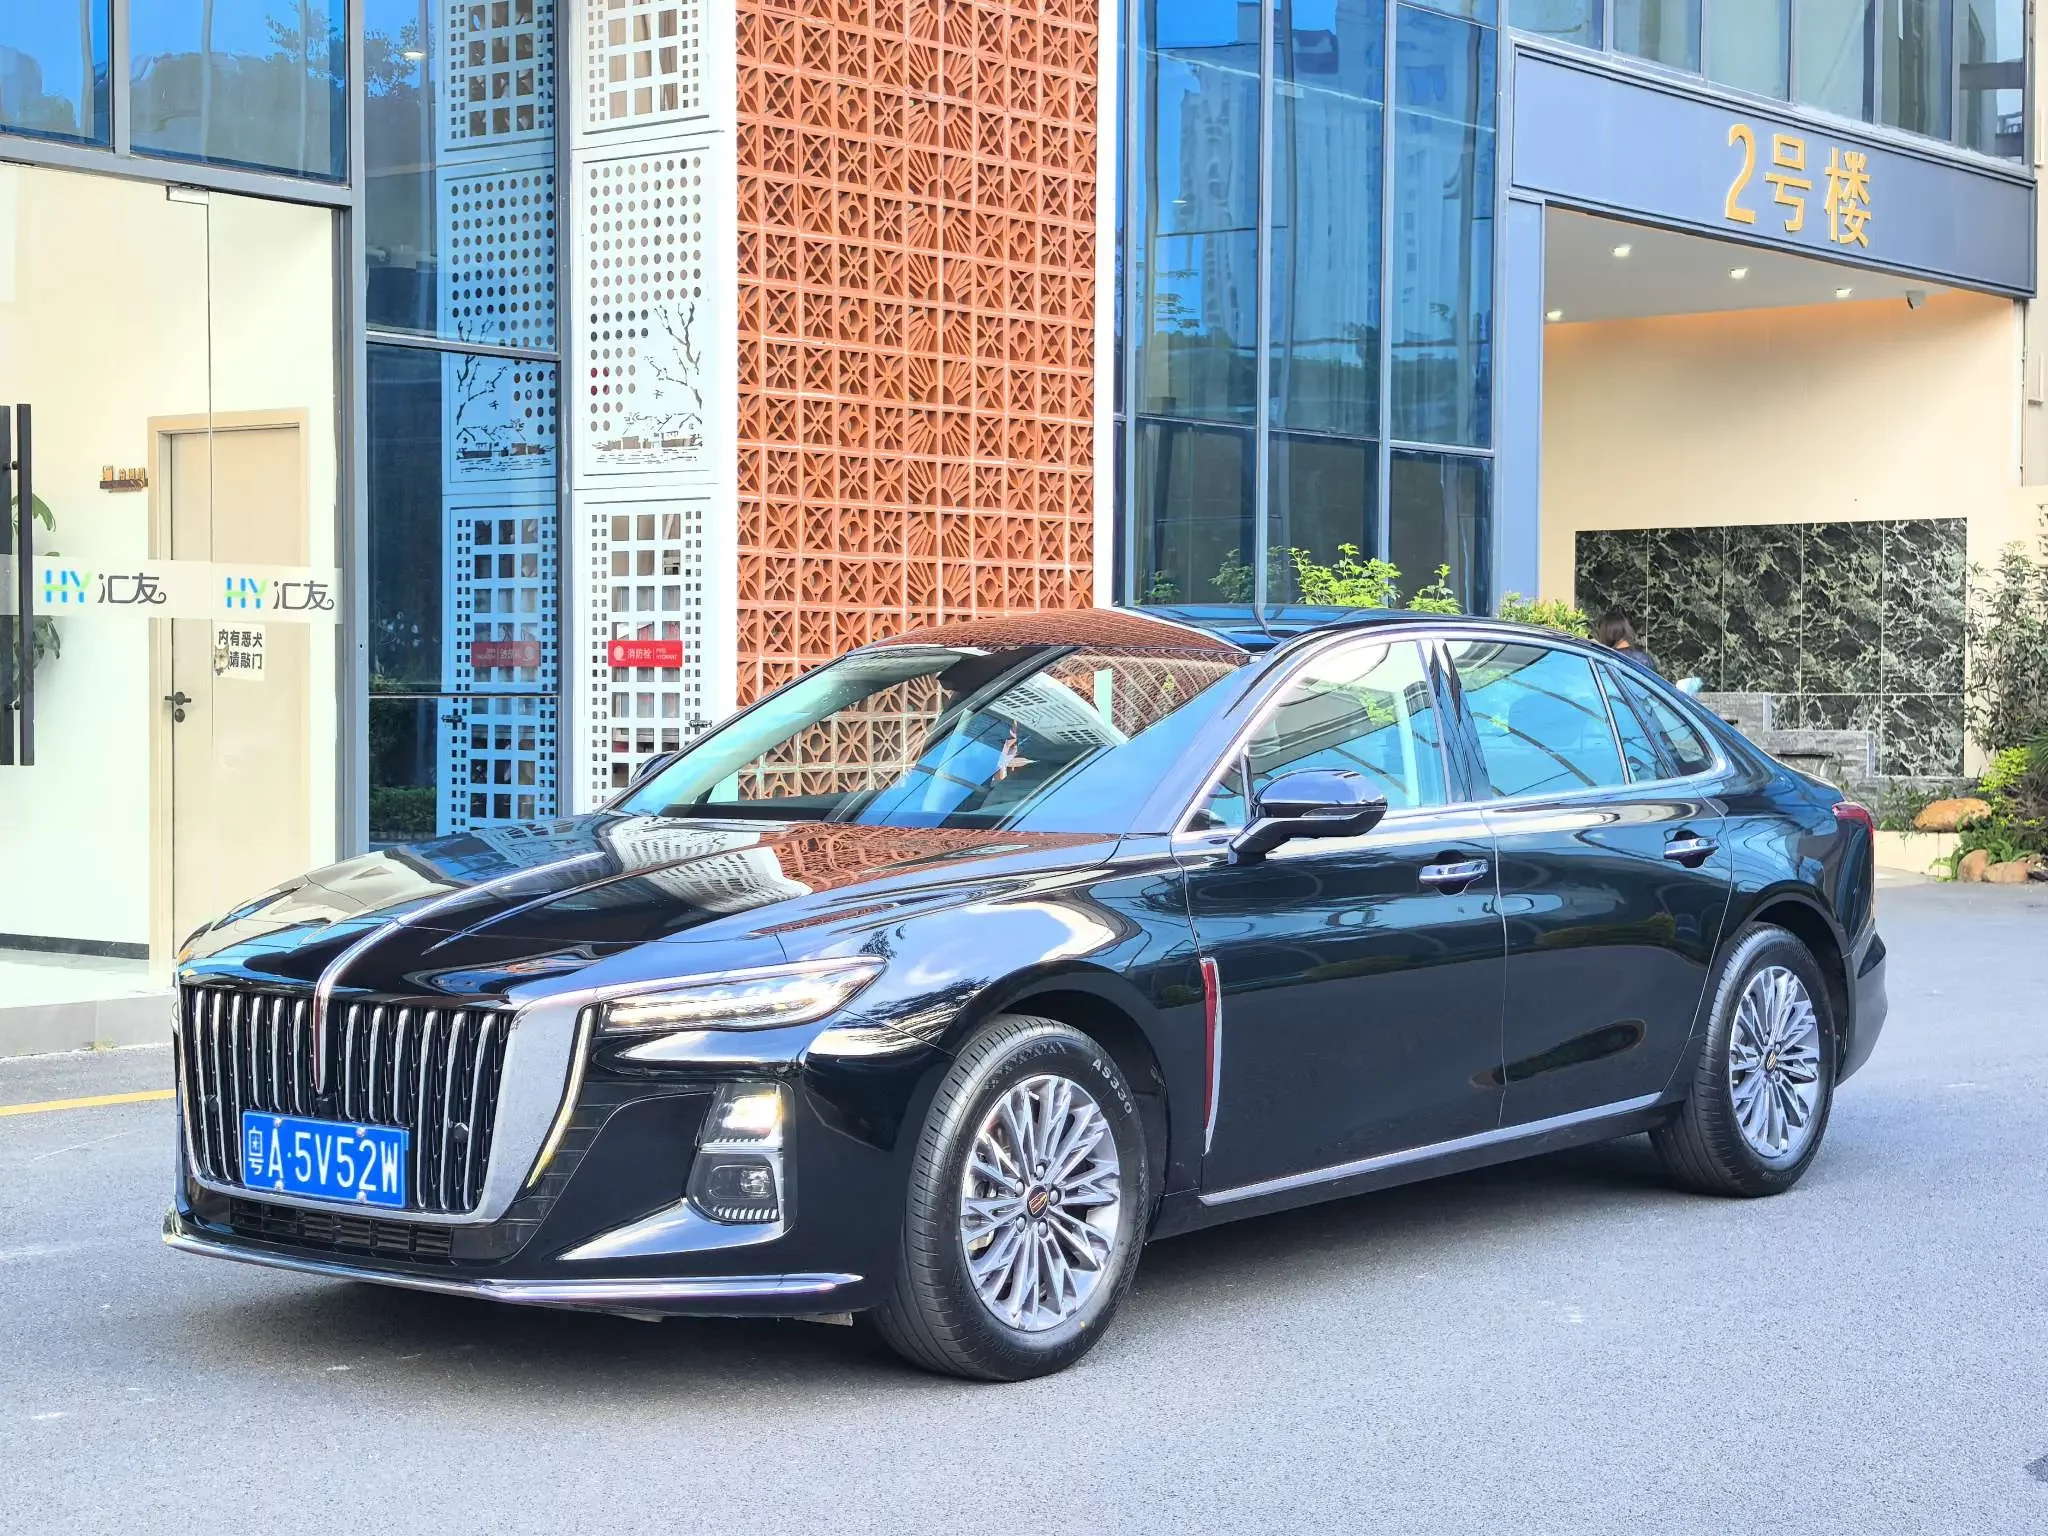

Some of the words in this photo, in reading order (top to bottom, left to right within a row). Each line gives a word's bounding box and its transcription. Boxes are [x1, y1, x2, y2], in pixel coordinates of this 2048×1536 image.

[1725, 123, 1872, 248] 2号楼
[41, 569, 92, 602] HY
[97, 572, 168, 604] 汇友
[224, 577, 268, 608] HY
[272, 580, 335, 610] 汇友
[218, 628, 262, 648] 内有恶犬
[229, 651, 262, 670] 请敲门
